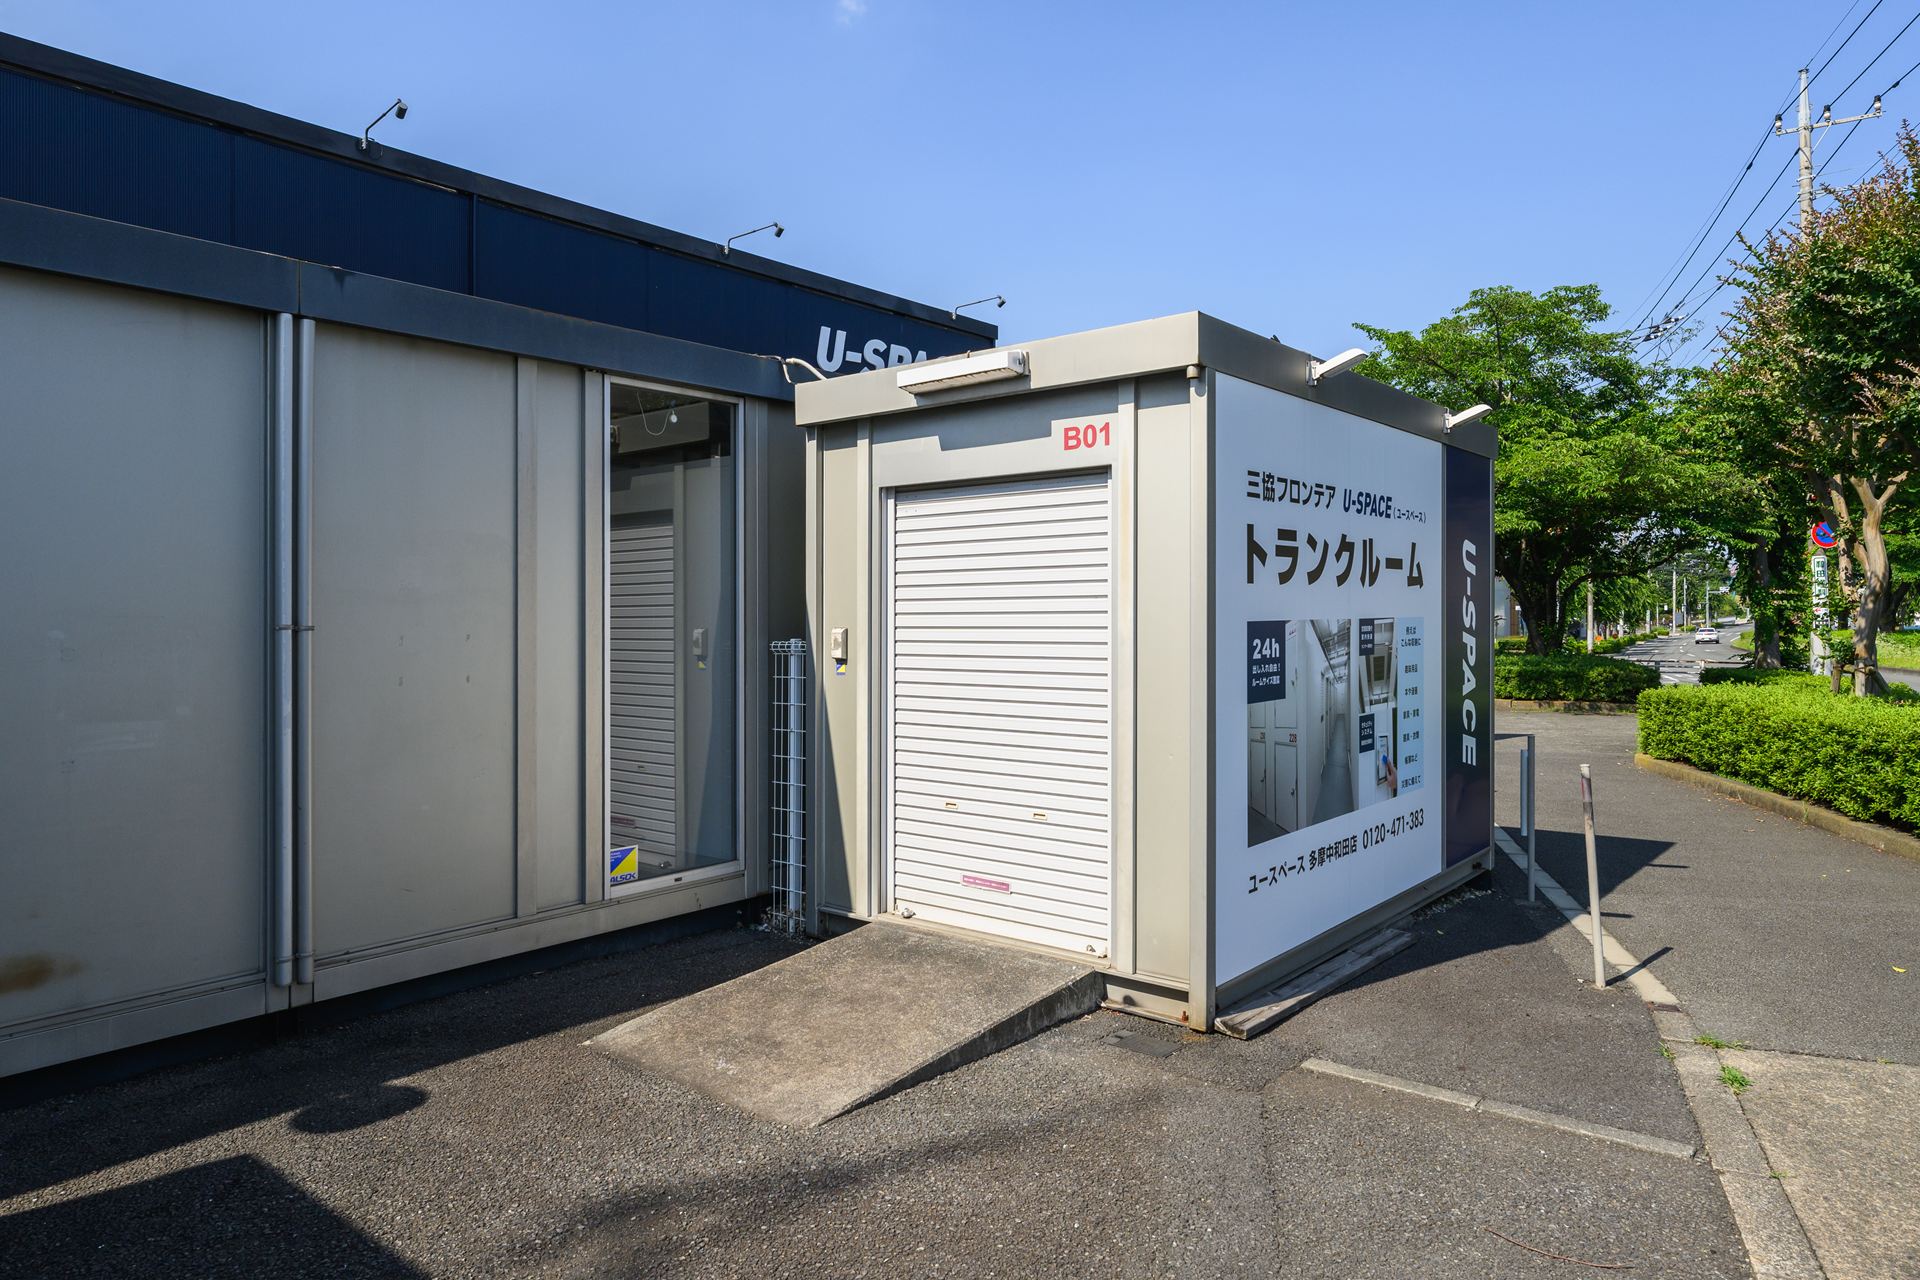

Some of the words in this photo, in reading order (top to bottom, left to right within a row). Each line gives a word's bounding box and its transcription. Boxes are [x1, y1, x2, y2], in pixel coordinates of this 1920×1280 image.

[1063, 421, 1111, 451] B01
[1246, 470, 1336, 510] 三協フロンテア
[1343, 488, 1393, 519] U-SPACE
[1246, 523, 1424, 589] トランクルーム
[1252, 637, 1280, 660] 24h
[1462, 538, 1477, 766] U-SPACE
[1248, 855, 1306, 894] ユースペース
[1308, 835, 1358, 871] 多摩中和田店
[1362, 808, 1425, 850] 0120-471-383
